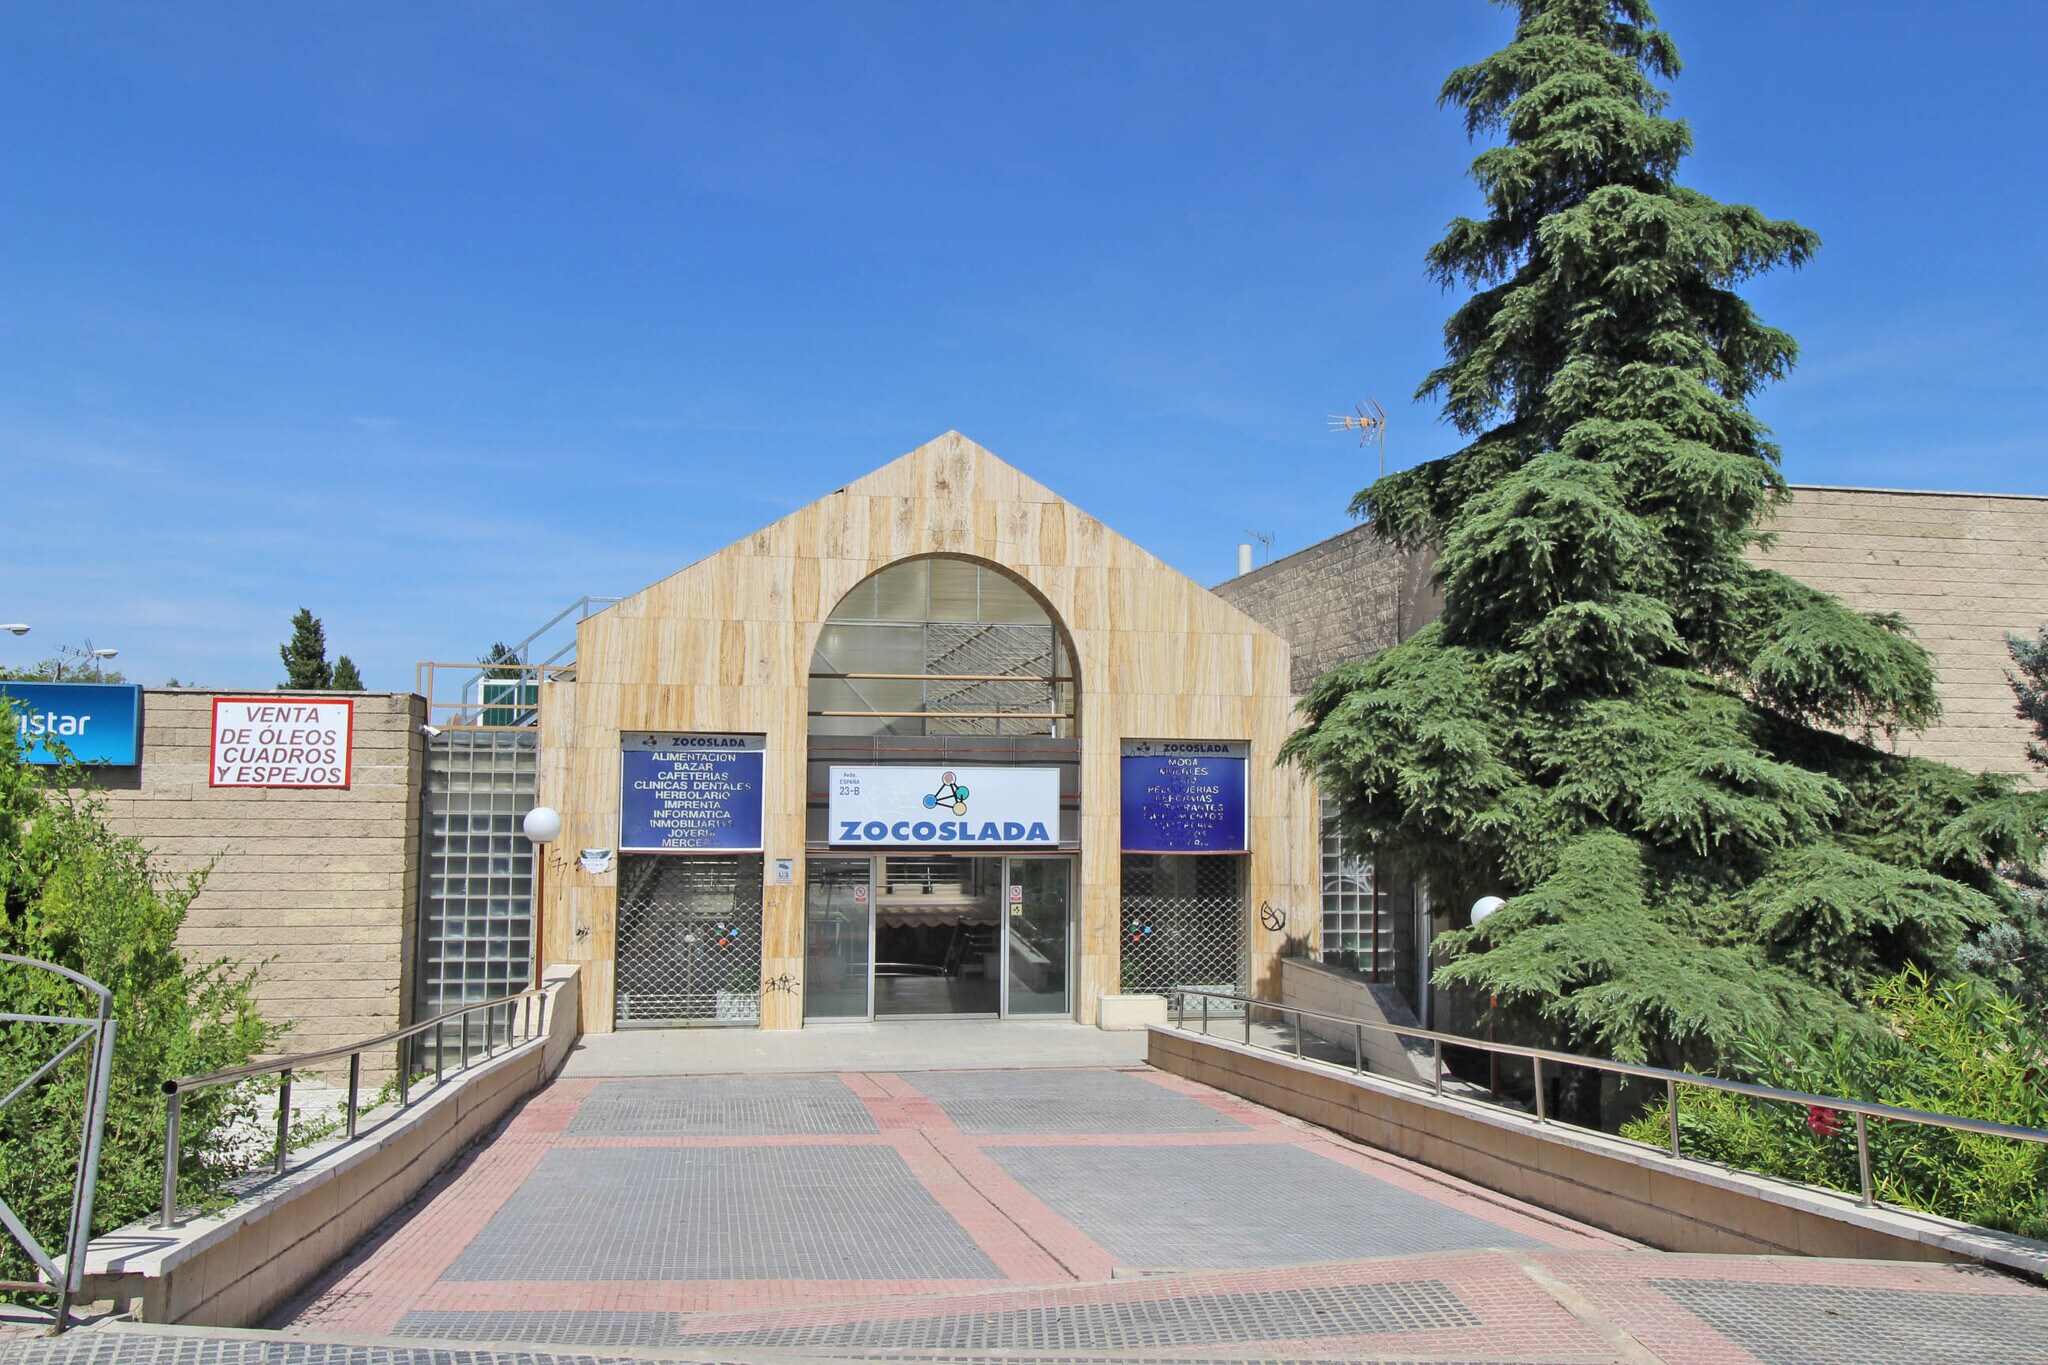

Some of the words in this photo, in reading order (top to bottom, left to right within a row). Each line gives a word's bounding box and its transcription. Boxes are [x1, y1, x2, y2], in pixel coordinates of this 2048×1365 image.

[246, 706, 320, 724] VENTA
[13, 711, 91, 736] istar
[220, 729, 252, 746] DE
[258, 725, 337, 746] ÓLEOS
[672, 737, 746, 748] ZOCOSLADA
[1163, 743, 1230, 753] ZOCOSLADA
[223, 747, 336, 765] CUADROS
[652, 752, 736, 762] ALIMENTACION
[674, 762, 713, 771] BAZAR
[1168, 757, 1198, 767] MODA
[217, 766, 232, 783] Y
[237, 766, 342, 784] ESPEJOS
[657, 771, 729, 781] CAFETERIAS
[634, 780, 688, 790] CLINICAS
[693, 781, 752, 791] DENTALES
[655, 790, 731, 800] HERBOLARIO
[839, 786, 860, 796] 23-B
[664, 800, 721, 809] IMPRENTA
[653, 809, 731, 819] INFORMATICA
[839, 820, 1050, 842] ZOCOSLADA
[662, 838, 721, 848] MERCER
